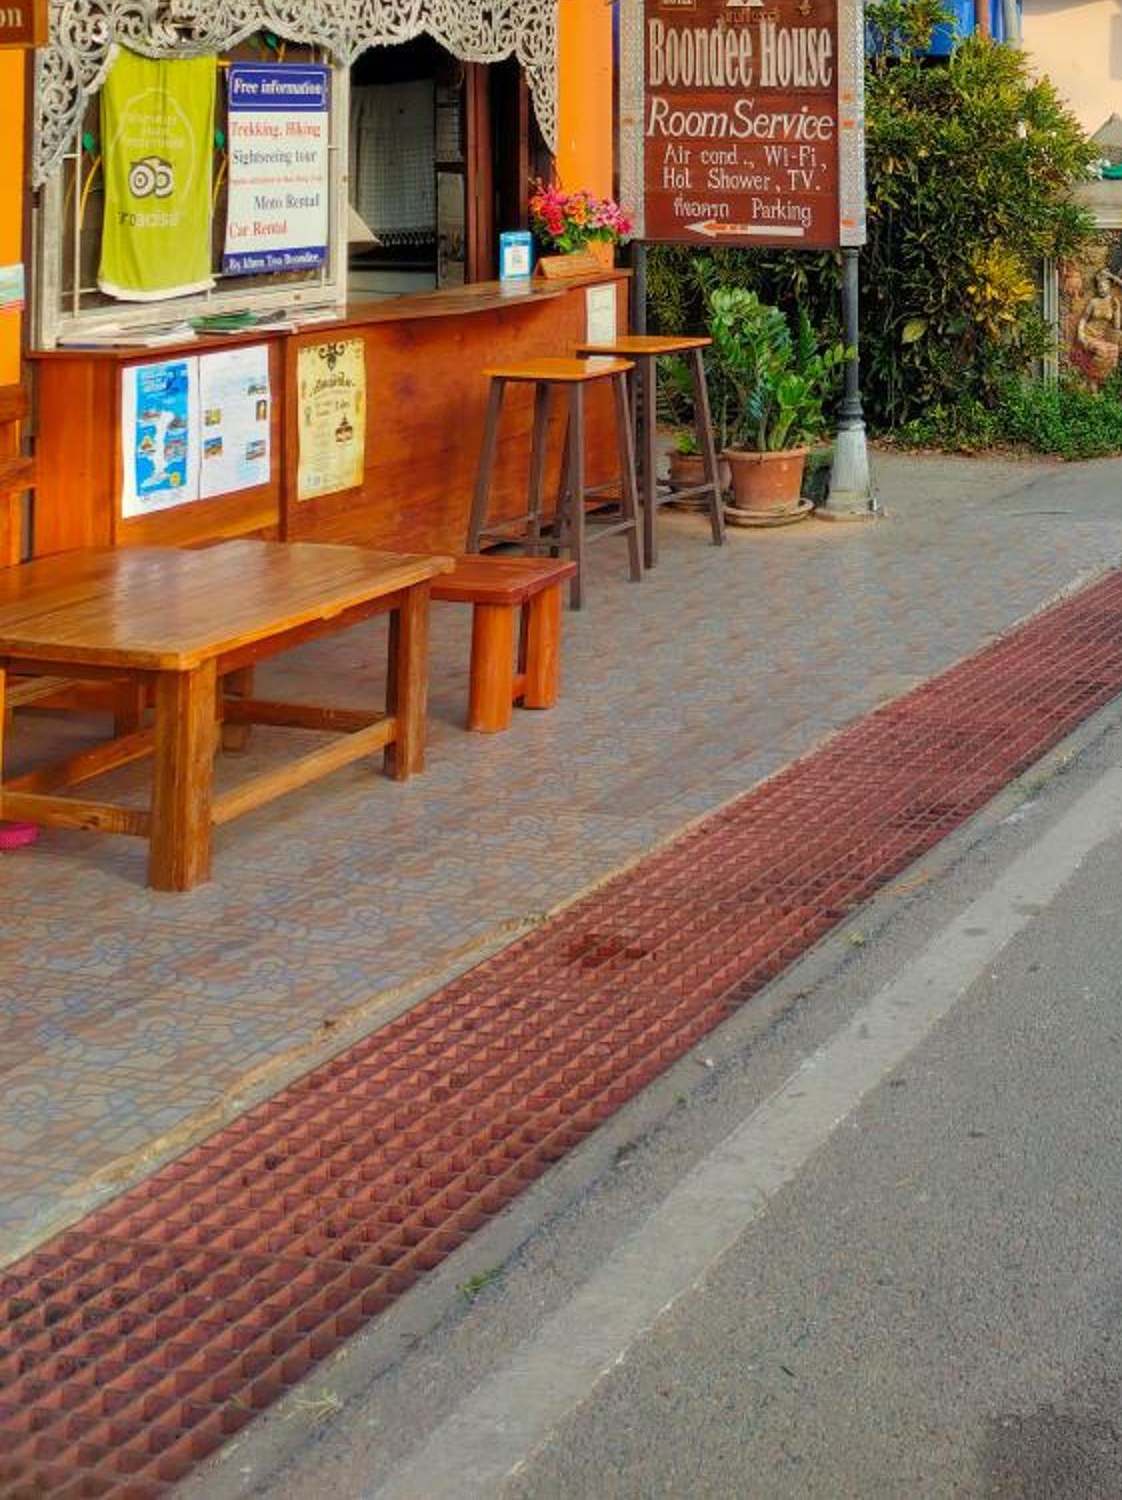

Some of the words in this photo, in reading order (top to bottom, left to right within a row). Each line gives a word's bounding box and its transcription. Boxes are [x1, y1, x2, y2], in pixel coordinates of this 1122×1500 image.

[648, 17, 753, 88] Boondee
[759, 17, 833, 88] House
[233, 77, 259, 95] Free
[261, 79, 322, 95] information
[646, 96, 729, 138] Room
[729, 98, 834, 140] Service
[663, 143, 693, 165] Air
[752, 197, 812, 228] Parking
